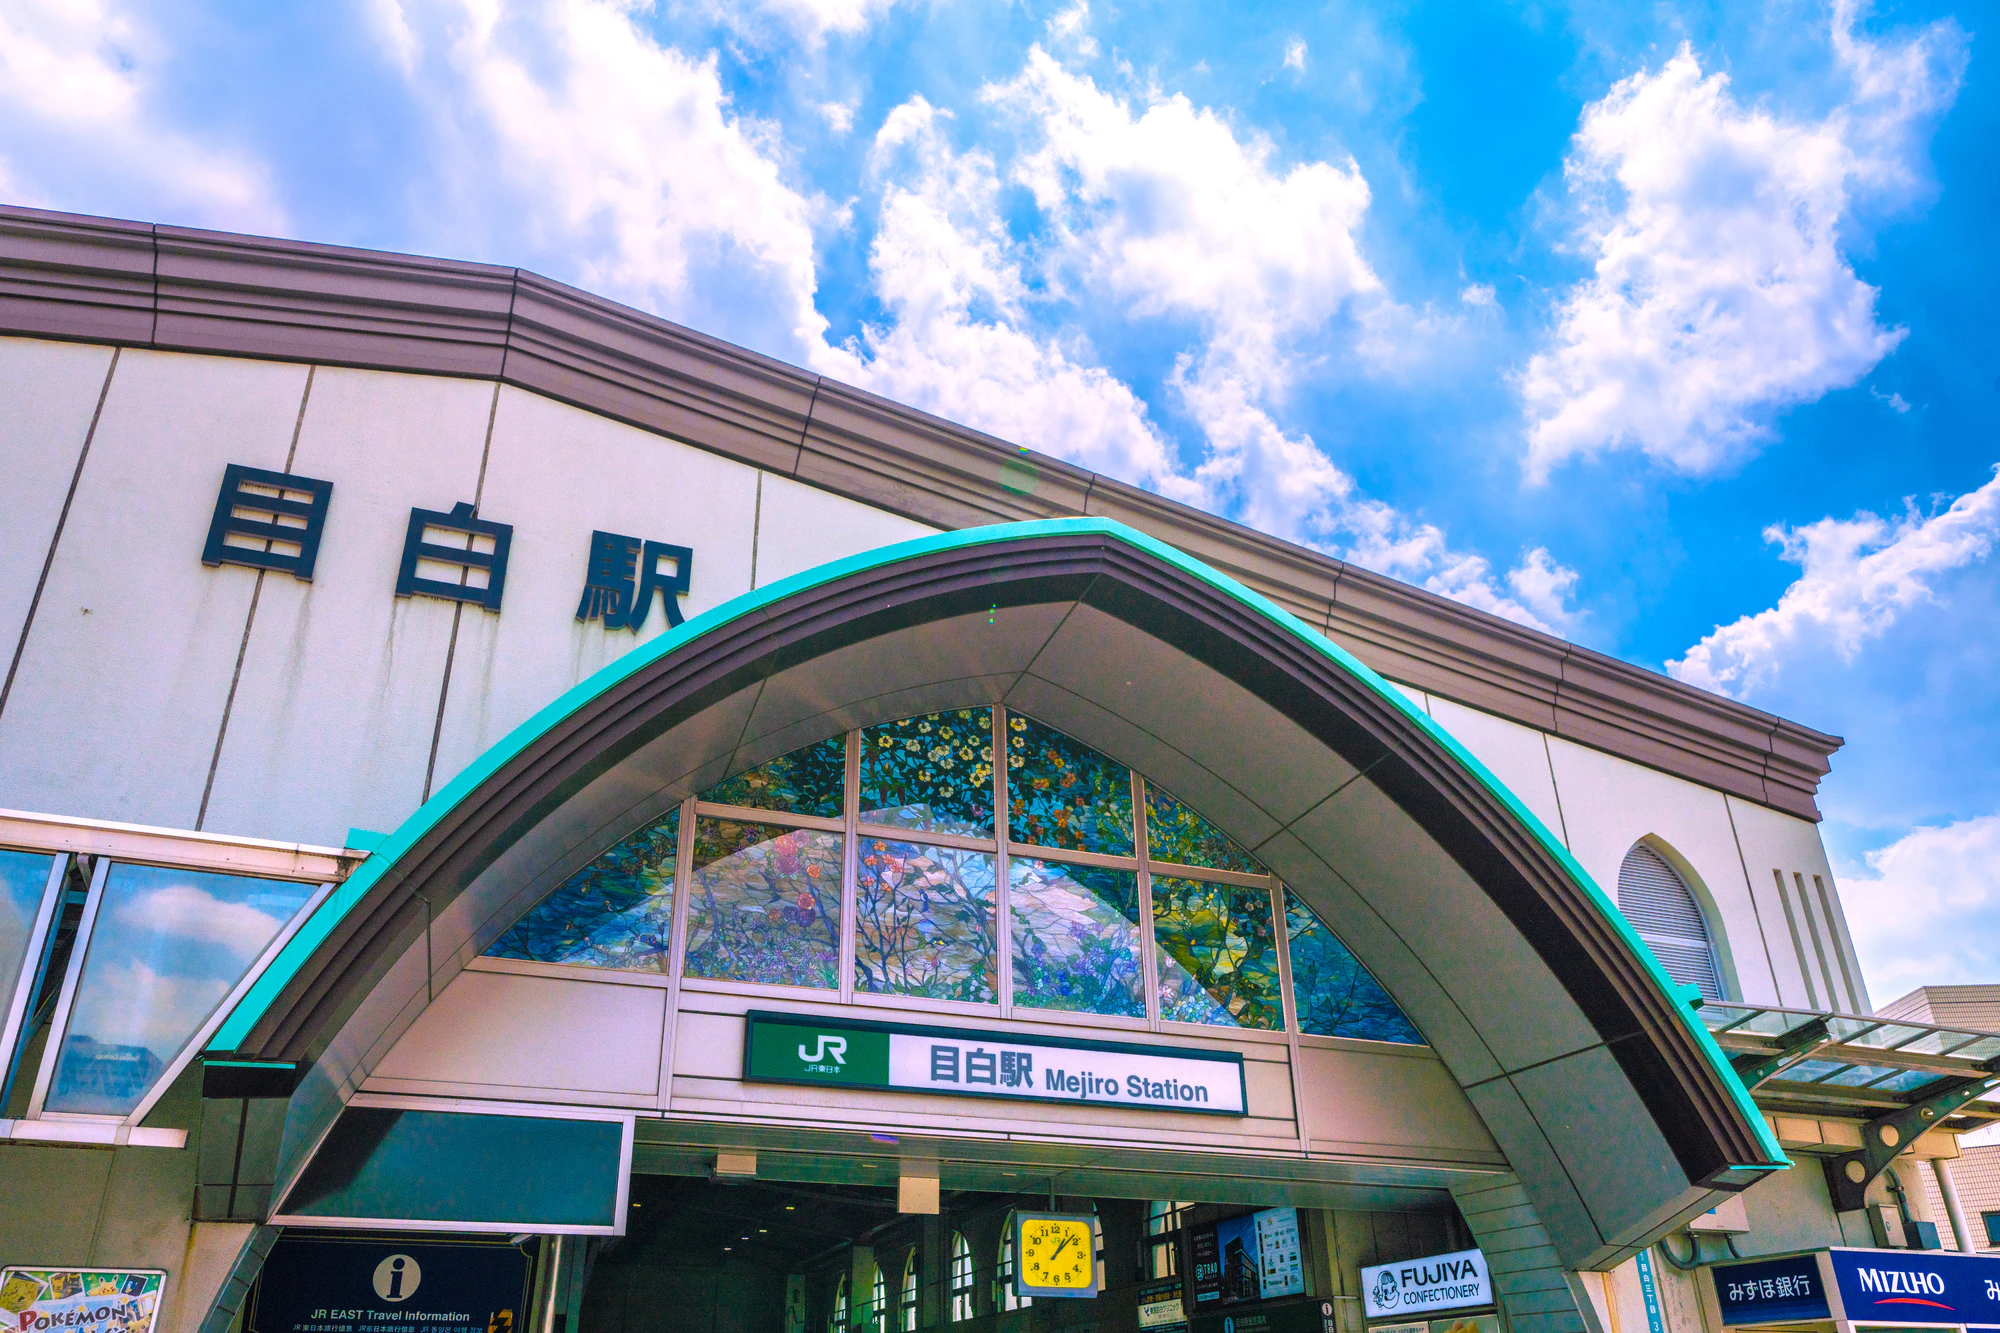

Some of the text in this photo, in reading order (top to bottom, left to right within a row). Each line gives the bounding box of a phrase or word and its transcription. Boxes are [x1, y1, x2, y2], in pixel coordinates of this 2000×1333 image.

[201, 463, 693, 635] 目白駅
[798, 1034, 847, 1064] JR
[804, 1064, 841, 1074] JR東日本
[930, 1045, 1209, 1102] 目白駅 Mejiro Station
[1028, 1249, 1034, 1257] 9
[1032, 1237, 1041, 1245] 10
[1072, 1238, 1079, 1246] 2
[1072, 1264, 1079, 1272] 4
[1401, 1259, 1478, 1288] FUJIYA
[1857, 1267, 1945, 1295] MIZUHO
[1403, 1283, 1480, 1305] CONFECTIONERY
[1640, 1263, 1656, 1314] 目白三丁目
[1653, 1321, 1660, 1332] 3
[1728, 1275, 1811, 1301] みずほ銀行
[19, 1303, 127, 1332] POKÉMON
[311, 1309, 470, 1321] JR EAST Travel Information
